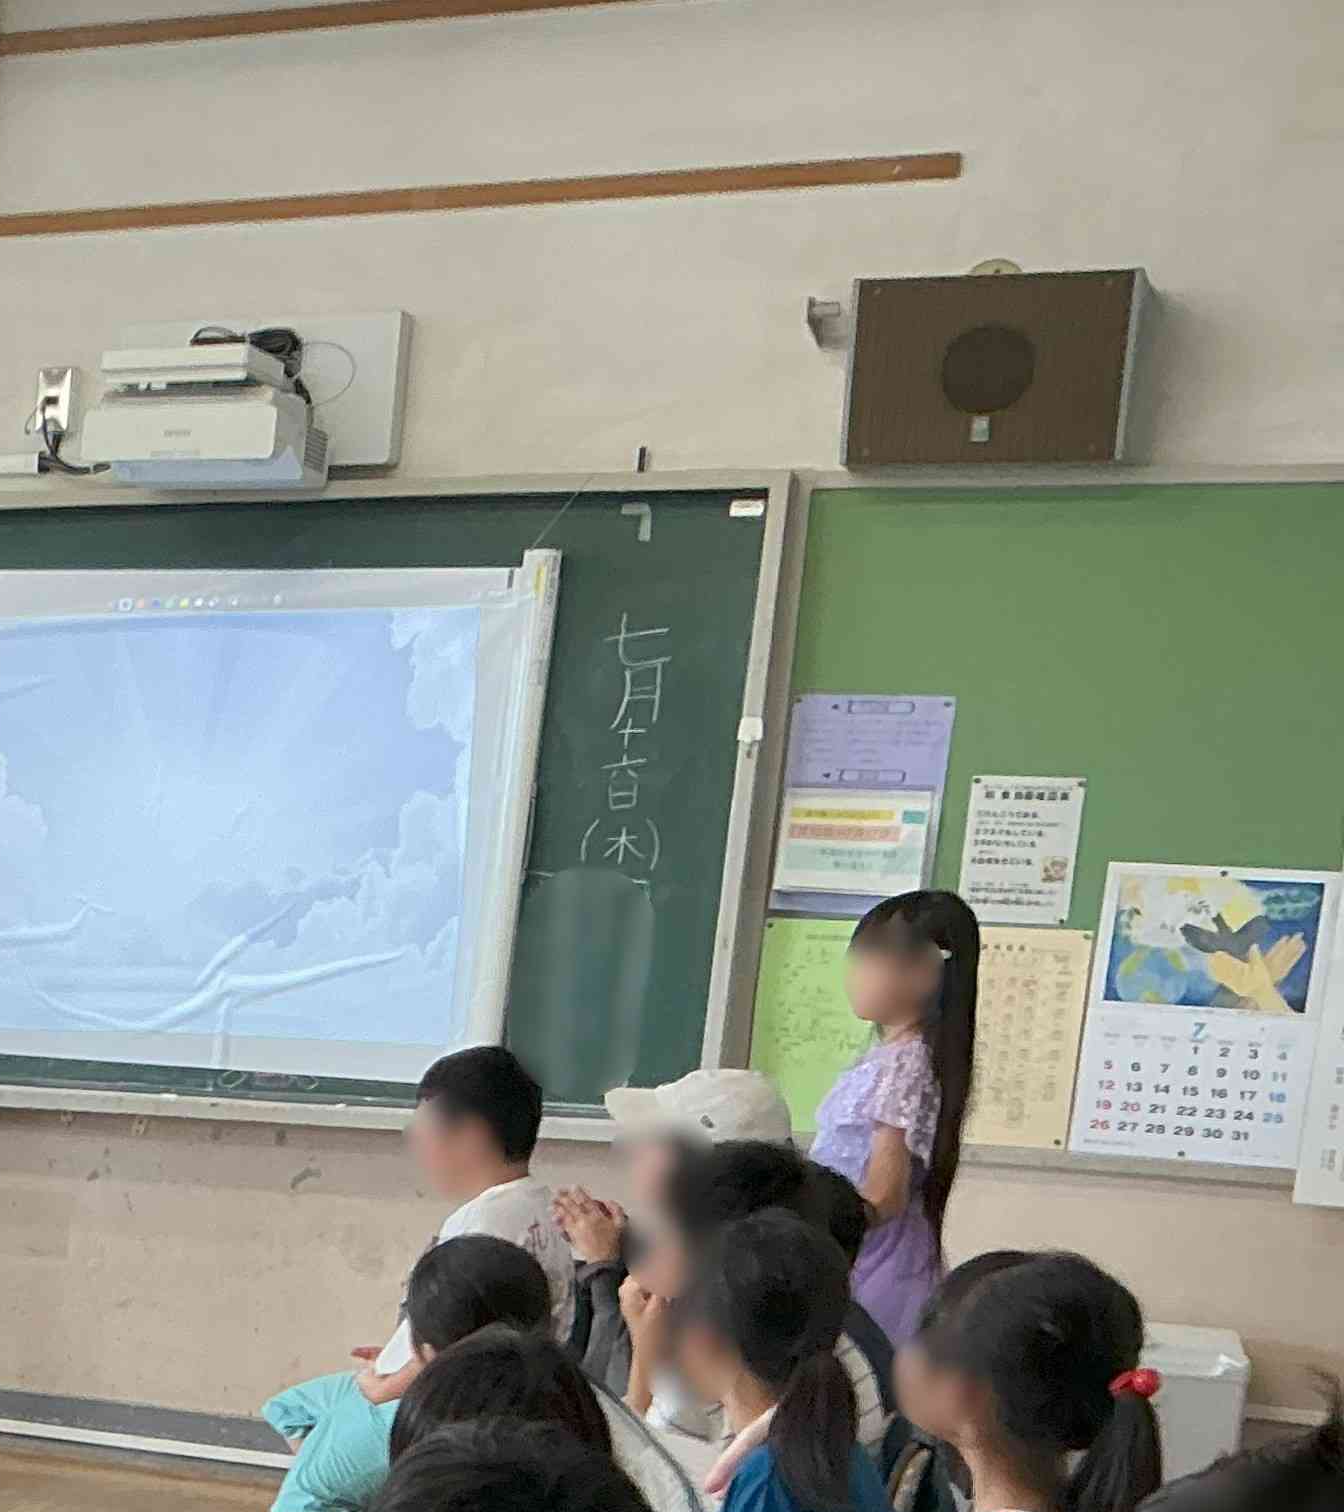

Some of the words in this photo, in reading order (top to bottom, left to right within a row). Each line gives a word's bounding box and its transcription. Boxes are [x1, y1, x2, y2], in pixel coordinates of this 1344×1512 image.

[1193, 1046, 1199, 1055] 1
[1219, 1048, 1230, 1058] 2
[1249, 1050, 1258, 1059] 3
[1104, 1061, 1112, 1070] 5
[1131, 1062, 1141, 1072] 6
[1161, 1064, 1170, 1073] 7
[1216, 1069, 1226, 1078] 9
[1243, 1071, 1260, 1081] 10
[1099, 1080, 1114, 1090] 12
[1126, 1082, 1143, 1092] 13
[1153, 1085, 1170, 1094] 14
[1182, 1086, 1199, 1096] 15
[1211, 1089, 1228, 1098] 16
[1240, 1091, 1256, 1101] 17
[1097, 1100, 1111, 1110] 19
[1120, 1102, 1140, 1112] 20
[1149, 1104, 1165, 1114] 21
[1176, 1106, 1197, 1116] 22
[1204, 1109, 1226, 1119] 23
[1234, 1111, 1254, 1121] 24
[1090, 1120, 1110, 1130] 26
[1117, 1122, 1138, 1132] 27
[1145, 1124, 1165, 1134] 28
[1174, 1126, 1194, 1136] 29
[1203, 1128, 1223, 1139] 30
[1232, 1130, 1248, 1141] 31
